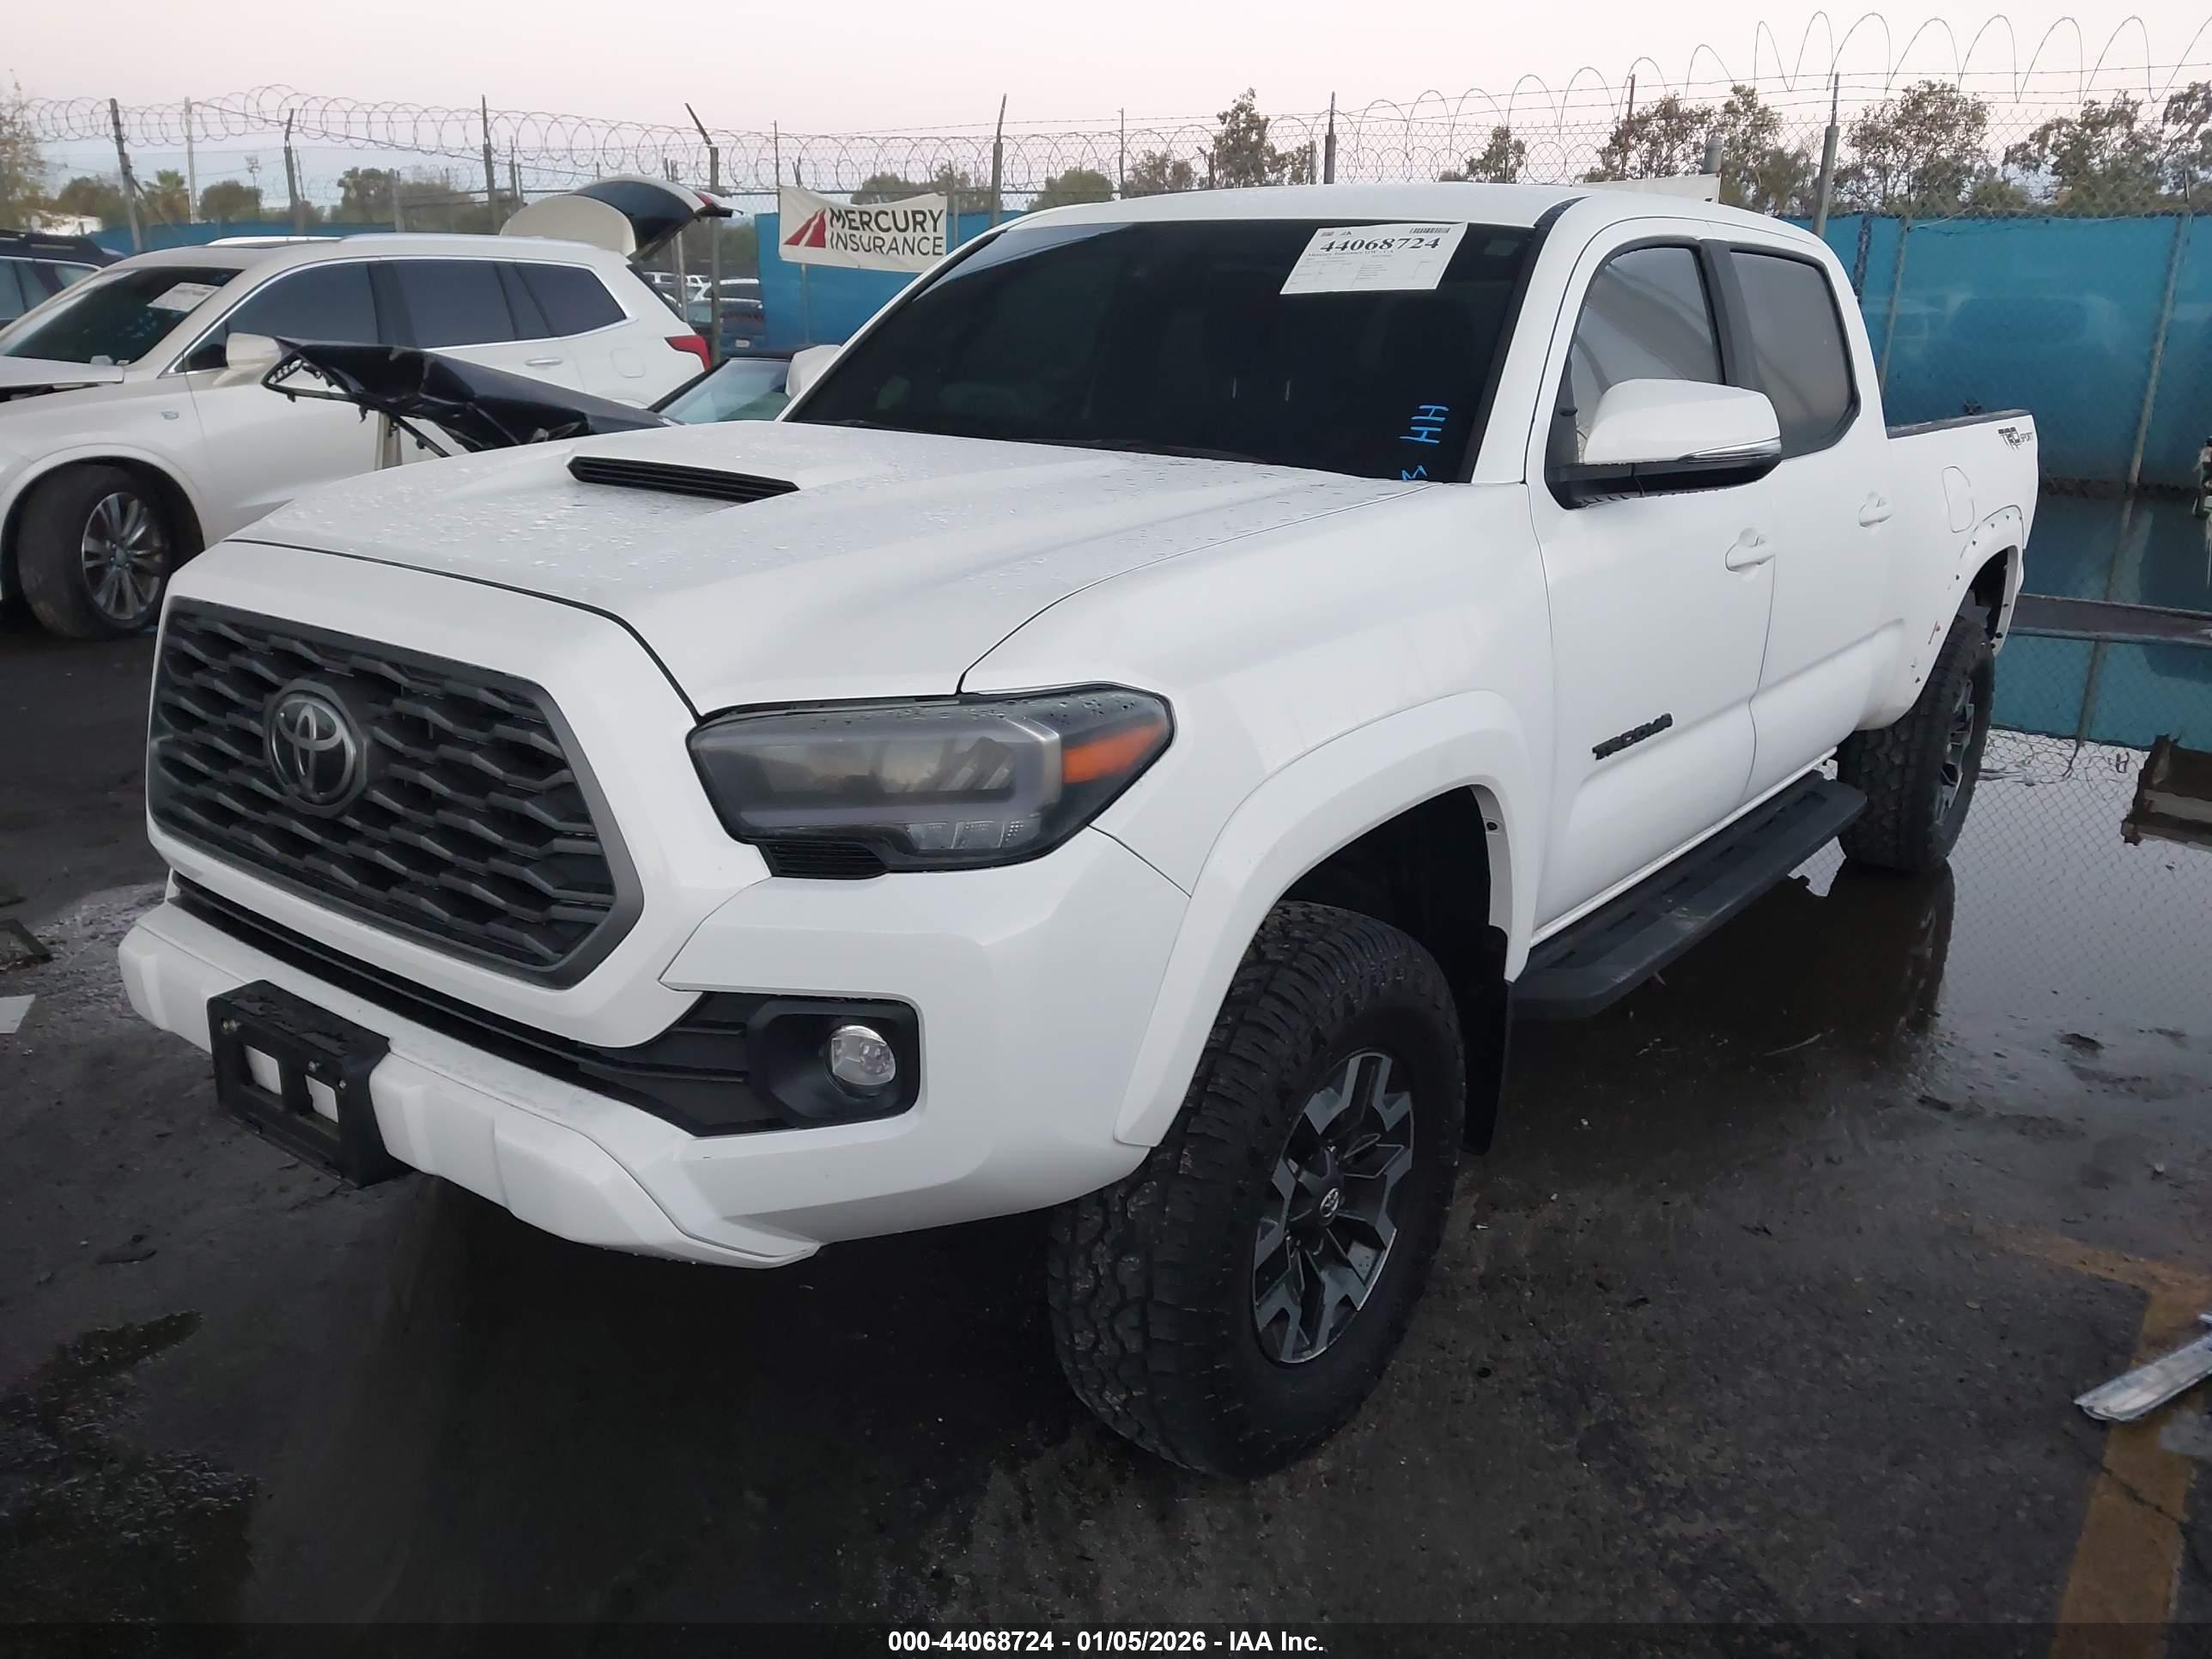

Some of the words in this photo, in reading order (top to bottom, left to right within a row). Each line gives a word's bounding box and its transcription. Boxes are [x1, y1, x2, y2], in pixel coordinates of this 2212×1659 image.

[830, 207, 945, 233] MERCURY
[830, 231, 944, 256] INSURANCE
[1320, 236, 1442, 252] 44068724
